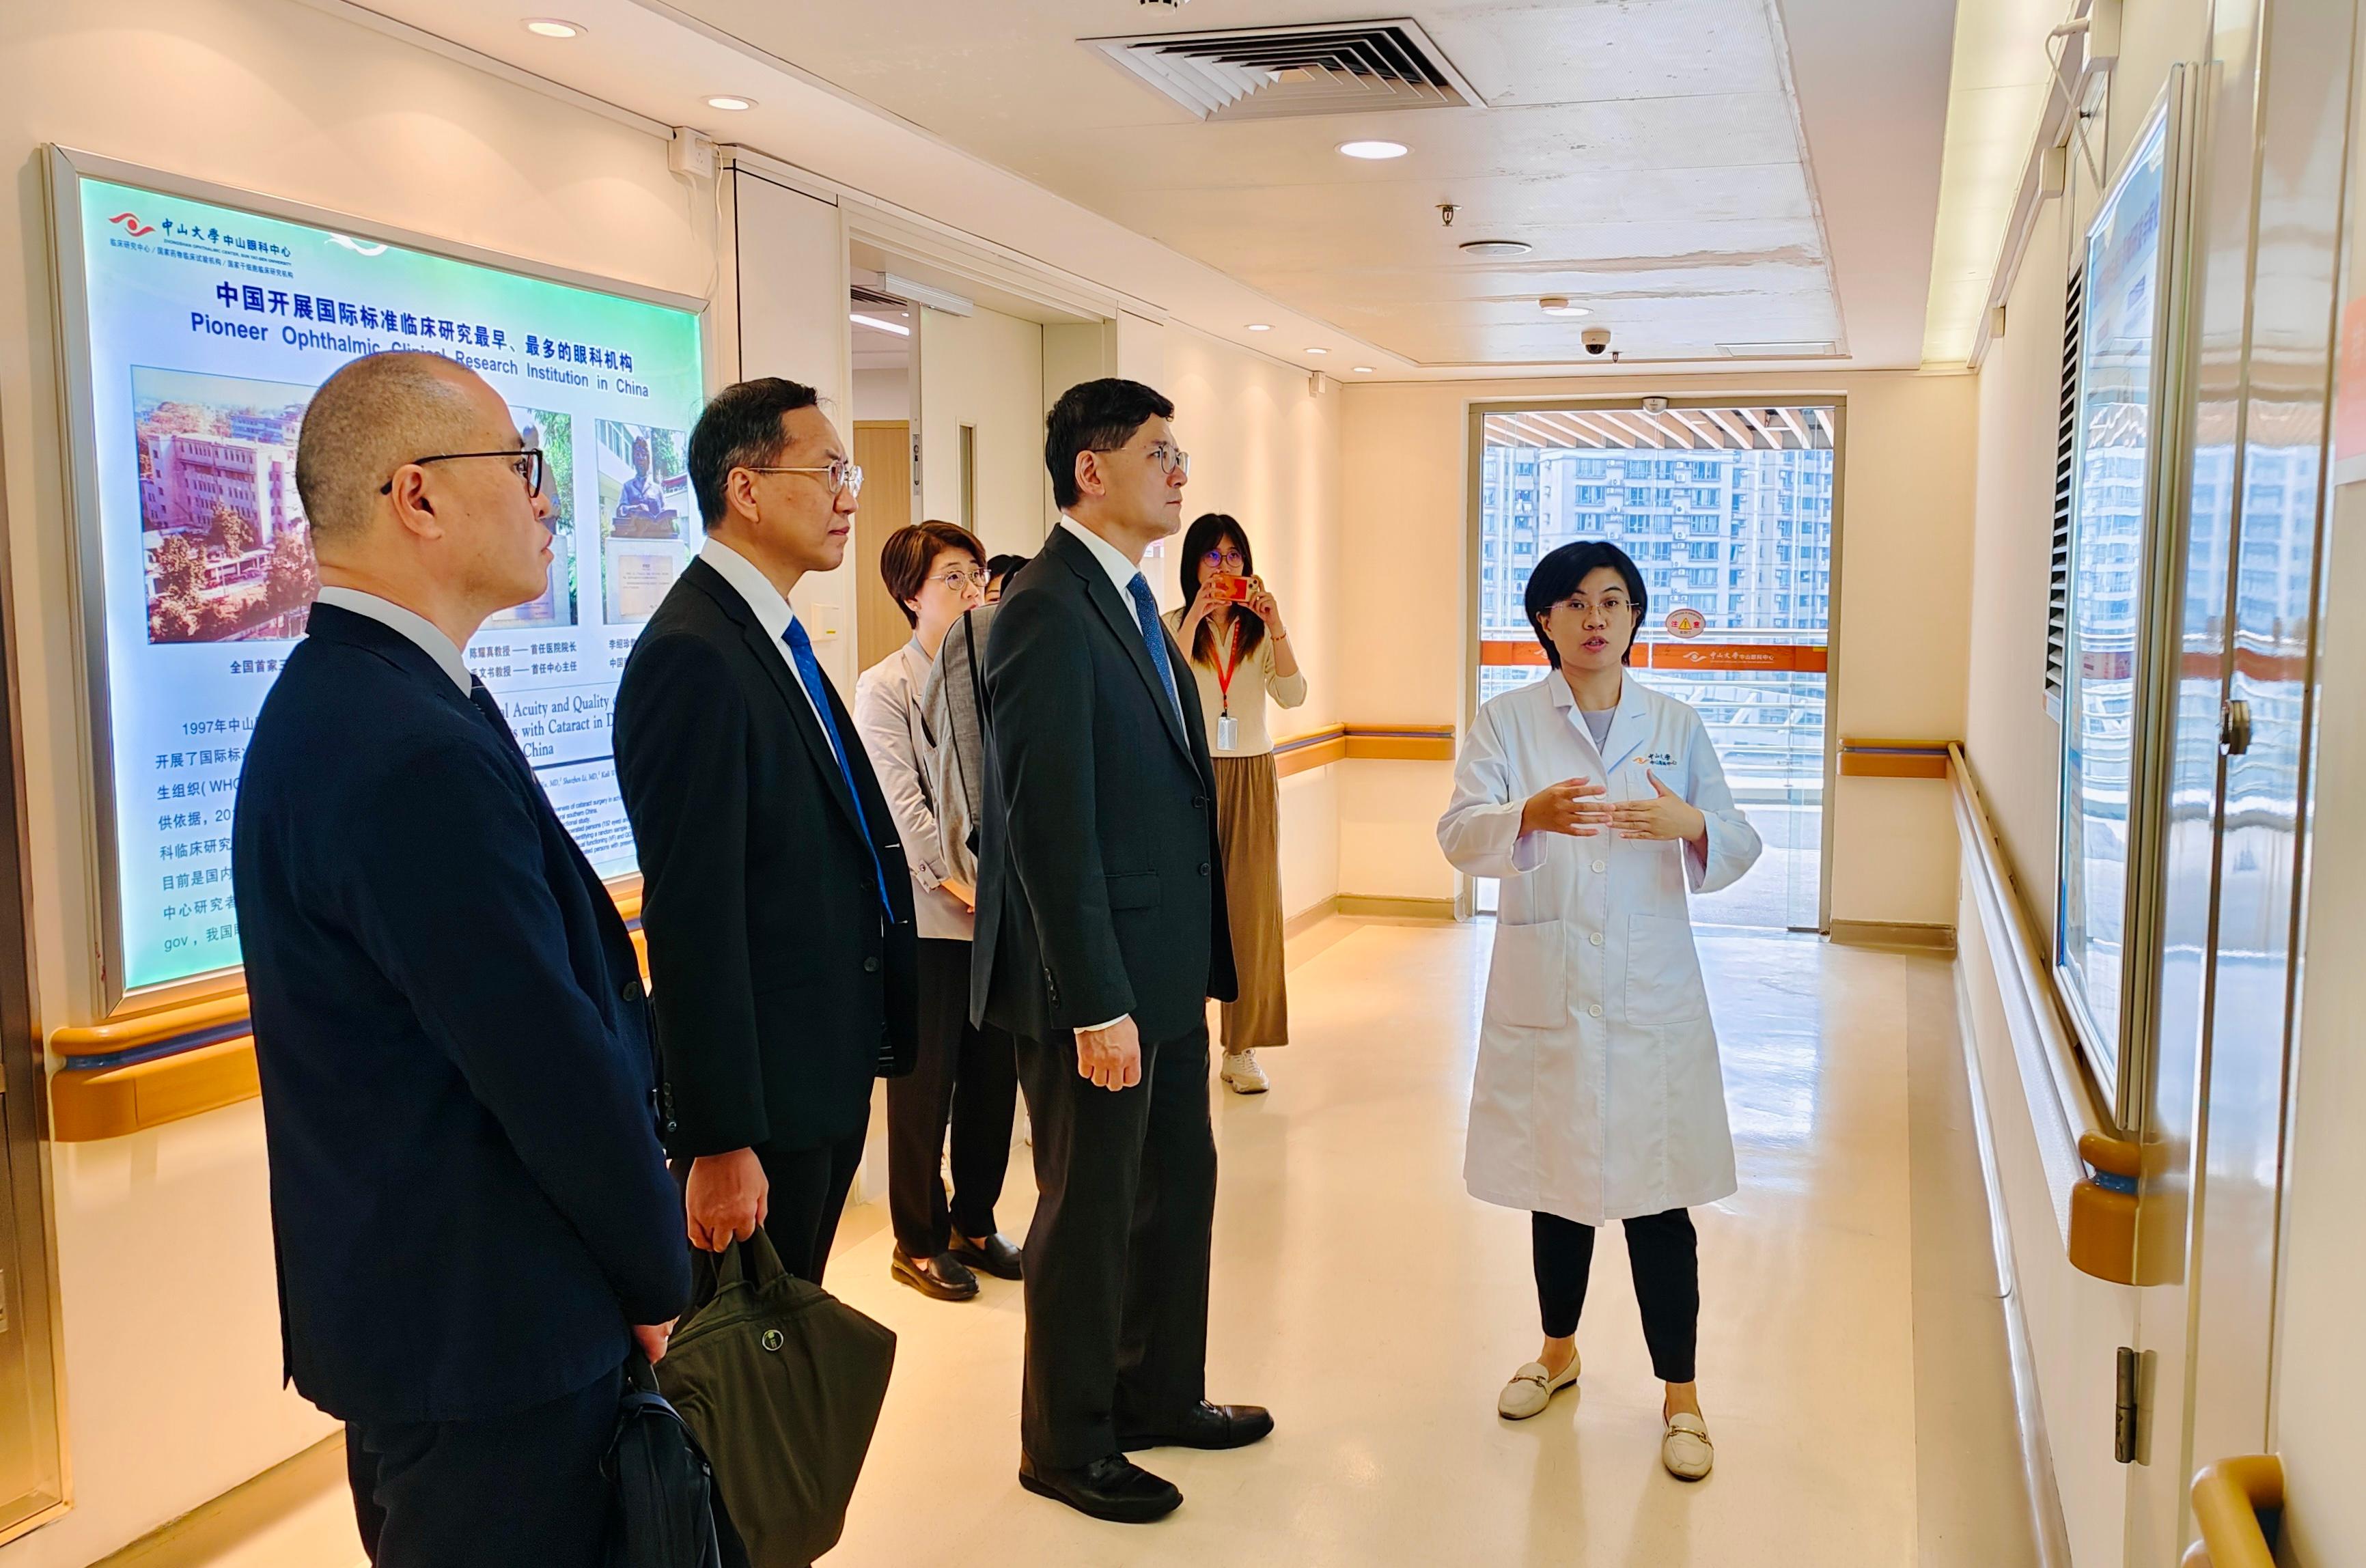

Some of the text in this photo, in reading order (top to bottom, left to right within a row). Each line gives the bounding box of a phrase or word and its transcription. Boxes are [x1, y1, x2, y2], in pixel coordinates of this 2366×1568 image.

[217, 281, 632, 373] 中国开展国际标准临床研究最早、最多的眼科机构
[191, 311, 268, 341] Pioneer
[282, 325, 380, 354] Ophthalmic
[456, 350, 518, 375] Research
[527, 363, 589, 387] Institution
[597, 375, 608, 390] in
[616, 378, 649, 397] China
[610, 657, 628, 669] 中国
[513, 701, 548, 718] Acuity
[552, 697, 570, 713] and
[573, 693, 609, 714] Quality
[182, 716, 258, 736] 1997年中山
[522, 720, 544, 738] with
[548, 718, 590, 734] Cataract
[594, 715, 603, 729] in
[155, 747, 245, 769] 开展了国际标
[523, 742, 554, 758] China
[158, 809, 236, 831] 供依据，20
